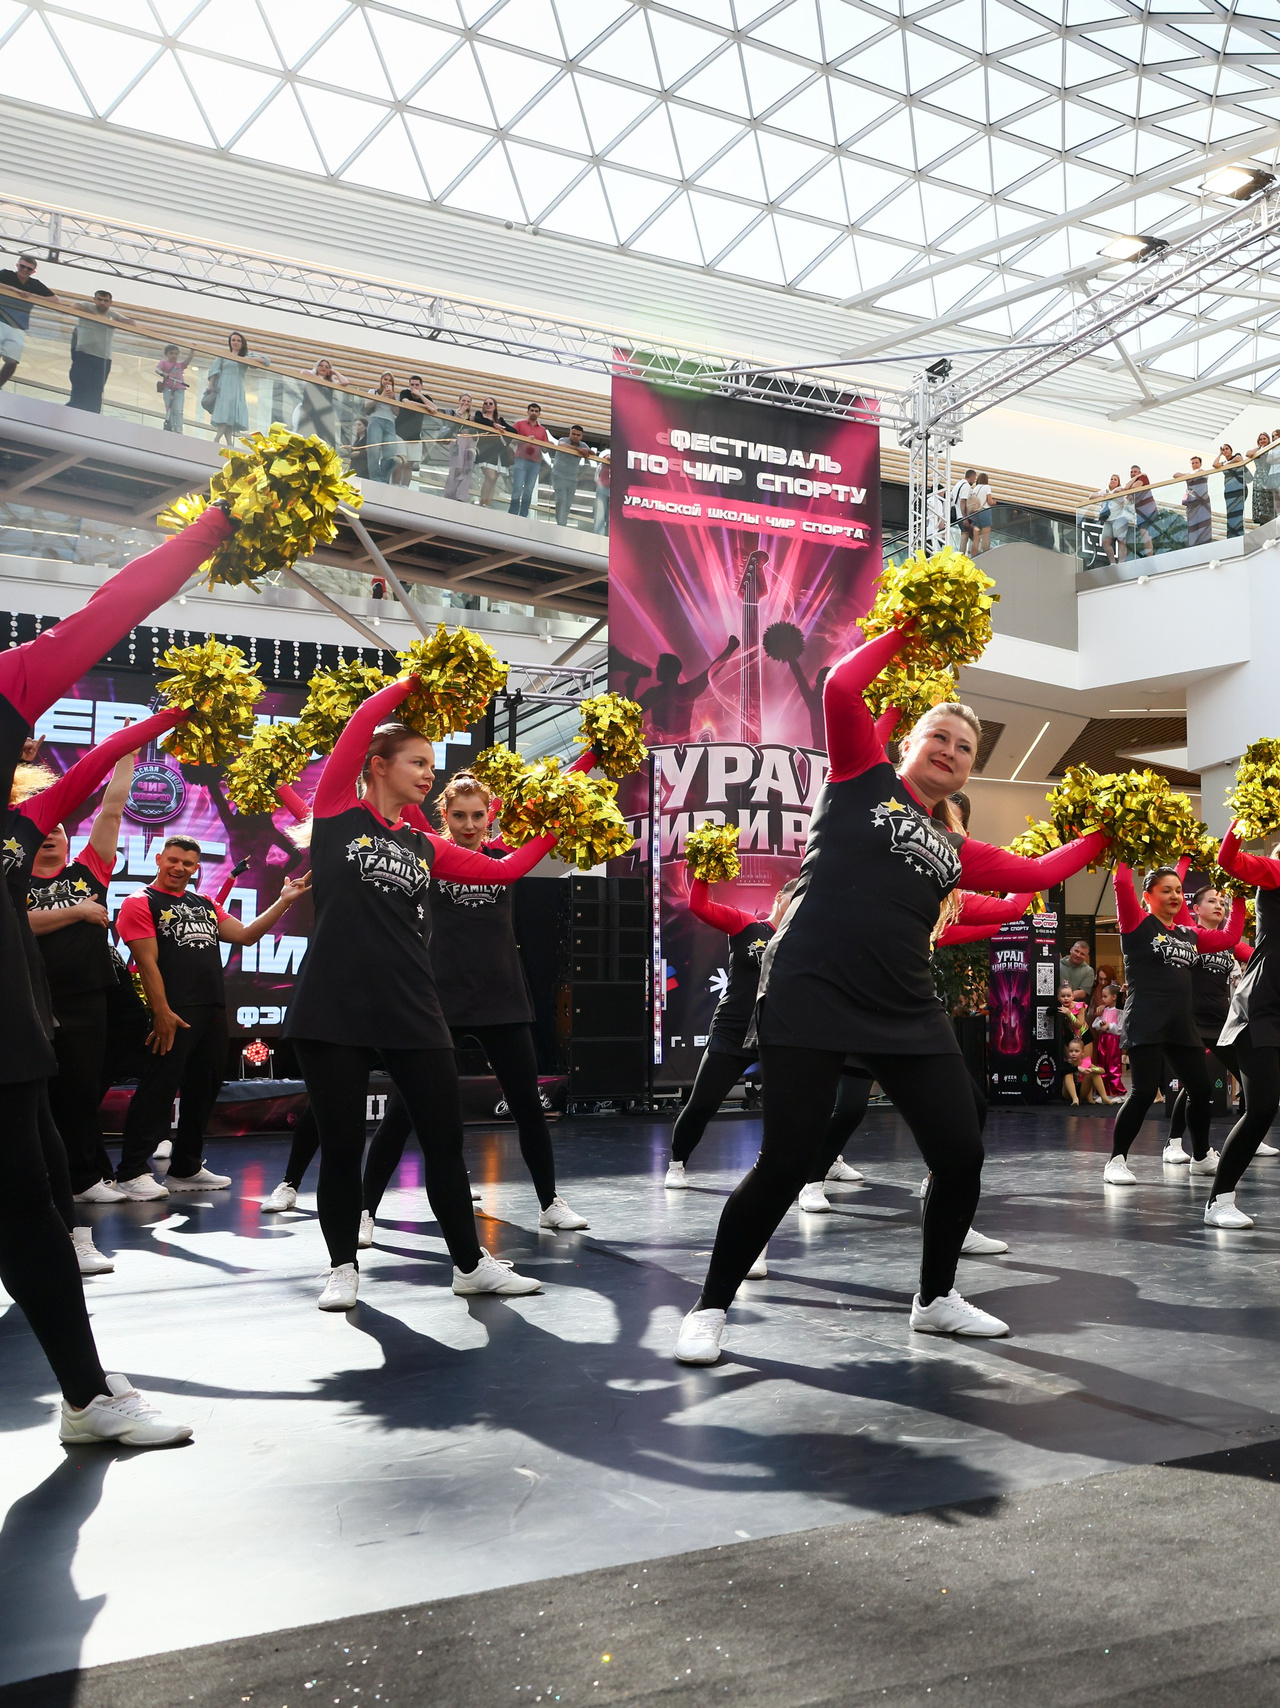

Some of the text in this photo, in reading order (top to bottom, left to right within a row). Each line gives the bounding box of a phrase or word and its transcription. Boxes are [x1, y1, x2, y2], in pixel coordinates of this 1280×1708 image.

[670, 429, 842, 474] ФЕСТИВАЛЬ
[627, 450, 867, 504] ПО ЧИР СПОРТУ
[624, 495, 864, 539] УРАЛЬСКОЙ ШКОЛЫ ЧИР СПОРТА
[897, 819, 962, 875] FAMILY
[364, 854, 424, 884] FAMILY
[452, 883, 499, 896] FAMILY
[991, 962, 1007, 972] ЧИР
[1013, 962, 1028, 972] РОК
[996, 950, 1024, 962] УРАЛ
[1166, 946, 1198, 964] FAMILY
[1204, 953, 1233, 969] FAMILY
